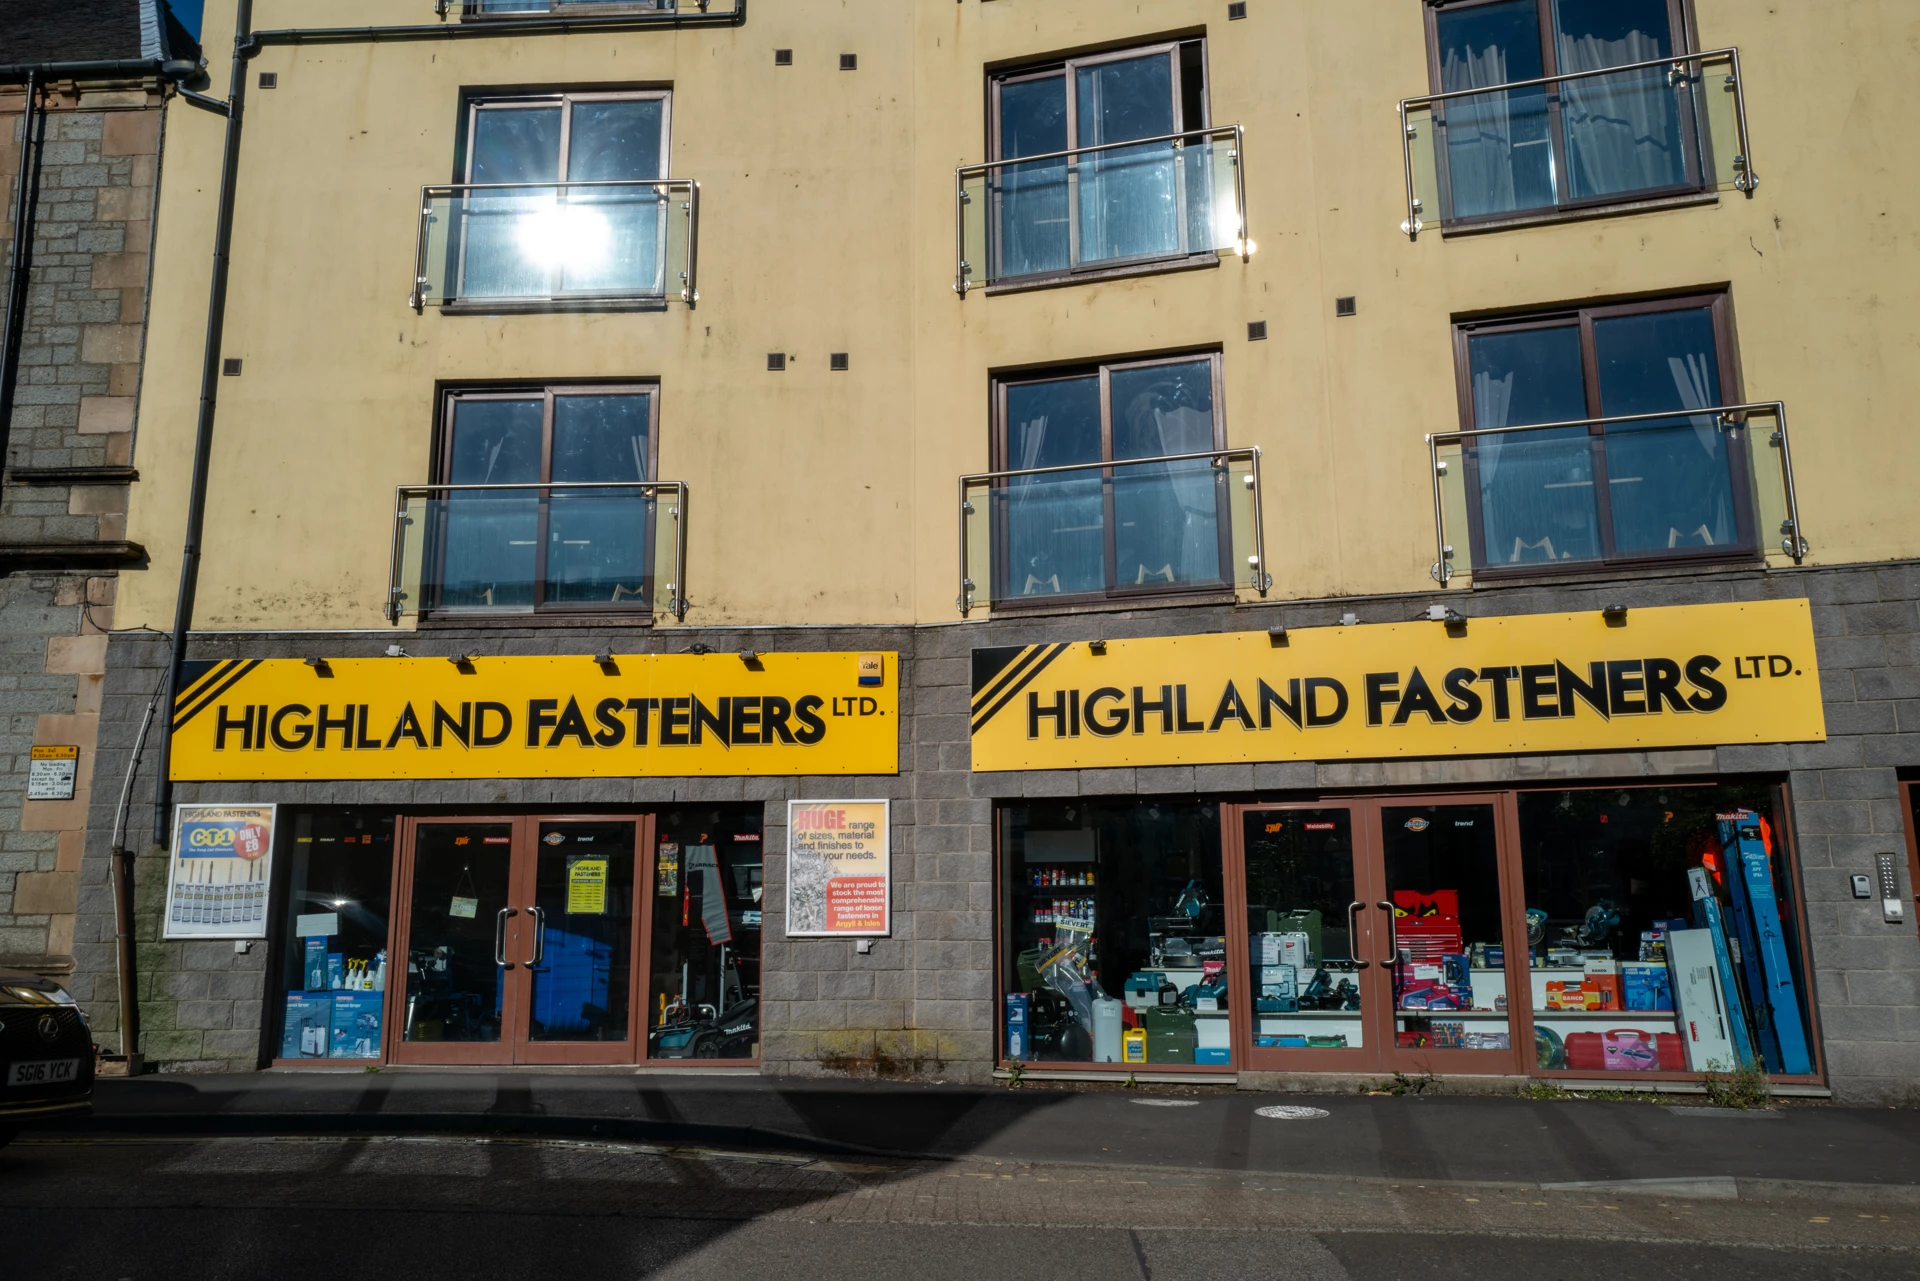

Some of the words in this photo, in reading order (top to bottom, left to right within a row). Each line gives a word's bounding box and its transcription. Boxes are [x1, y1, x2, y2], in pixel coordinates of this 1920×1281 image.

[1026, 677, 1349, 740] HIGHLAND
[1364, 654, 1727, 727] FASTENERS
[1734, 655, 1802, 679] LTD.
[213, 700, 512, 752] HIGHLAND
[525, 692, 826, 752] FASTENERS
[833, 697, 885, 716] LTD.
[798, 810, 846, 830] HUGE
[848, 821, 875, 832] range
[240, 826, 261, 841] ONLY
[798, 831, 806, 840] of
[809, 831, 835, 840] sizes,
[838, 831, 874, 839] material
[245, 839, 259, 853] £8
[798, 841, 815, 850] and
[817, 841, 852, 849] finishes
[798, 851, 820, 860] meet
[823, 852, 844, 862] your
[846, 851, 876, 860] needs.
[836, 920, 856, 928] Argyll
[1060, 919, 1090, 928] SIEVERT
[17, 1064, 46, 1082] SG16
[50, 1061, 72, 1079] YCK
